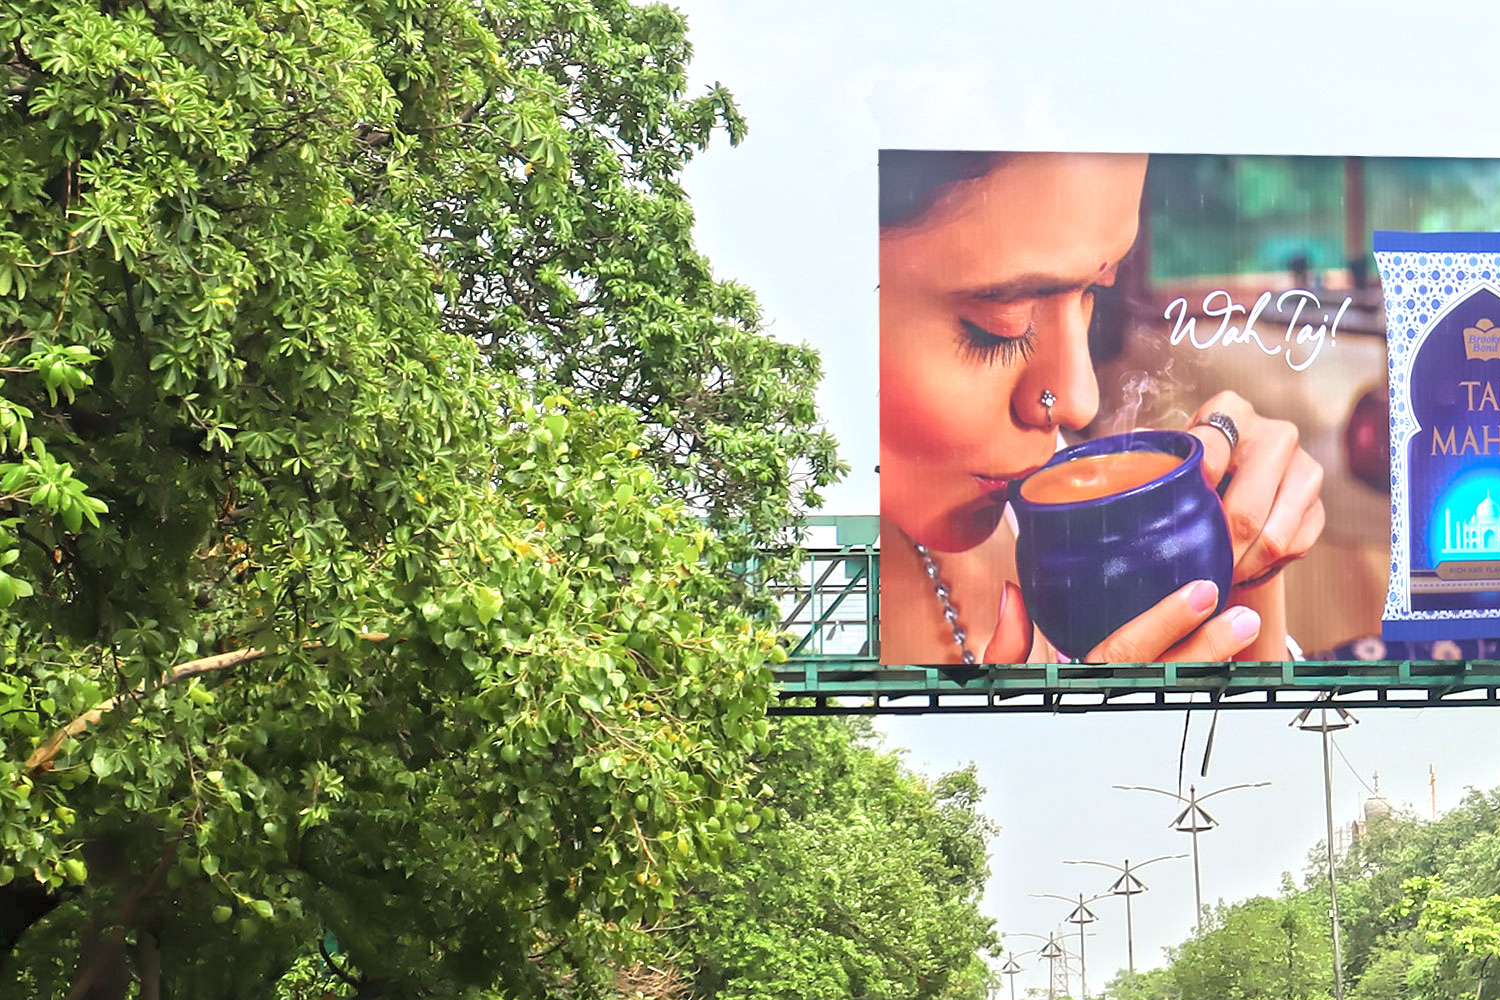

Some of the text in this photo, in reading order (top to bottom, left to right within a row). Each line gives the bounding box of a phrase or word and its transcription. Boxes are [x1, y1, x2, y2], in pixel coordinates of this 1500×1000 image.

[1163, 289, 1353, 371] Wah Taj!
[1472, 343, 1499, 353] Bond
